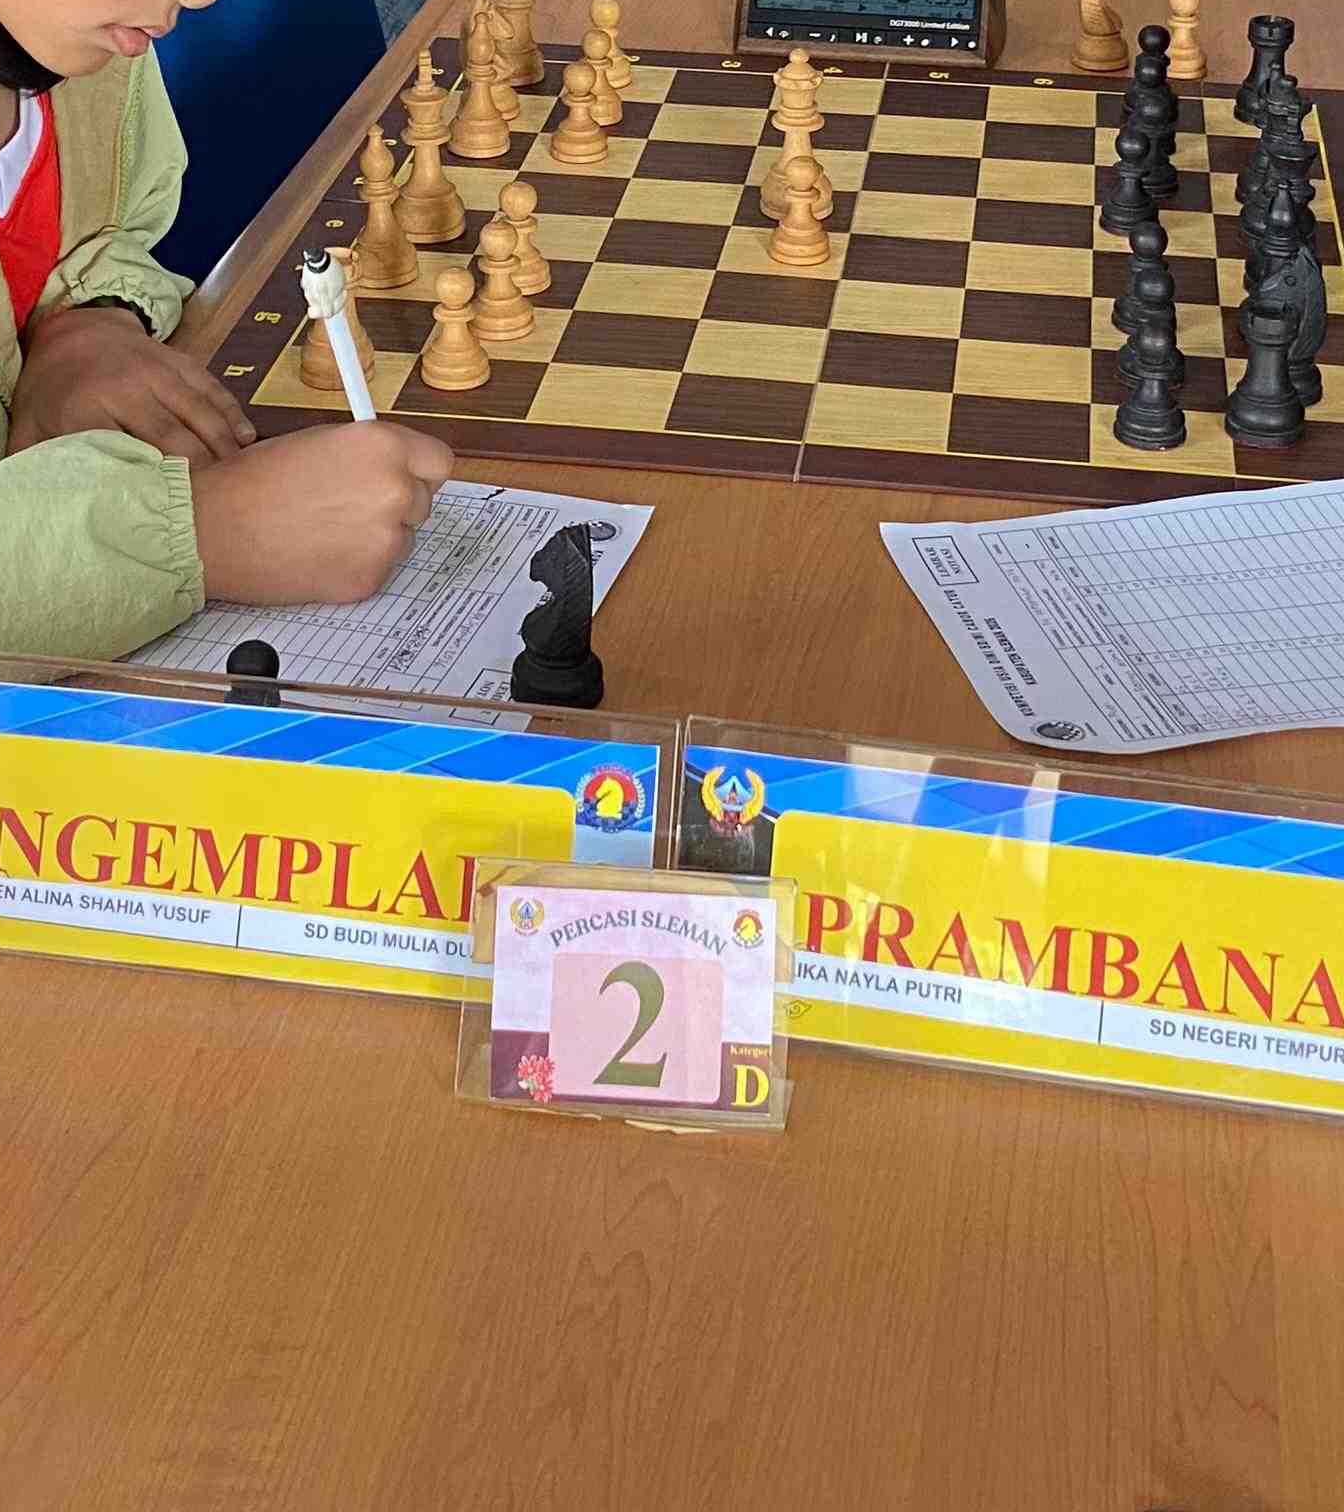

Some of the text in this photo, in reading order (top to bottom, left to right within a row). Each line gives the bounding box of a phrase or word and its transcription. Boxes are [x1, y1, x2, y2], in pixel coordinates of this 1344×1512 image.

[21, 889, 74, 908] ALINA
[79, 894, 146, 917] SHAHIA
[151, 904, 212, 925] YUSUF
[303, 921, 472, 959] SD BUDI MULIA DU
[549, 909, 729, 956] PERCASI SLEMAN
[797, 962, 963, 1004] IKA NAYLA PUTRI
[592, 960, 668, 1089] 2
[1148, 1018, 1177, 1038] SD
[1181, 1024, 1258, 1051] NEGERI
[729, 1063, 770, 1108] D
